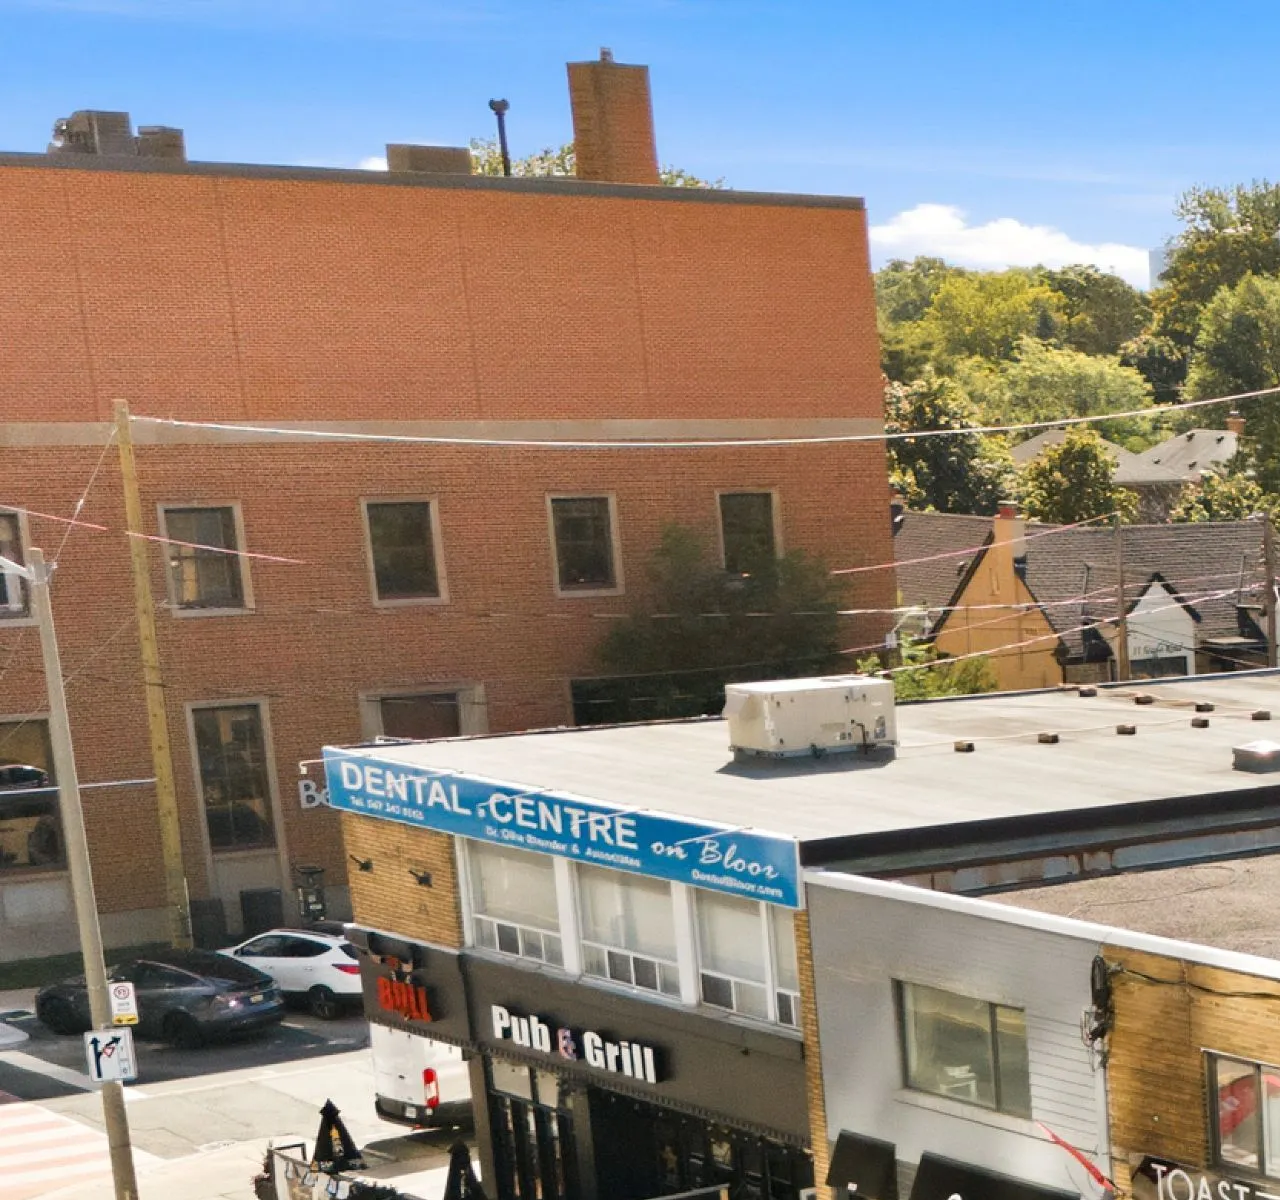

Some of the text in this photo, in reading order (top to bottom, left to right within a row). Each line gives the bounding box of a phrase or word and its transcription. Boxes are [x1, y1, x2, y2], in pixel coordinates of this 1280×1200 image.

[340, 760, 780, 879] DENTAL CENTRE on Bloor
[491, 1004, 551, 1053] Pub
[582, 1030, 658, 1085] Grill
